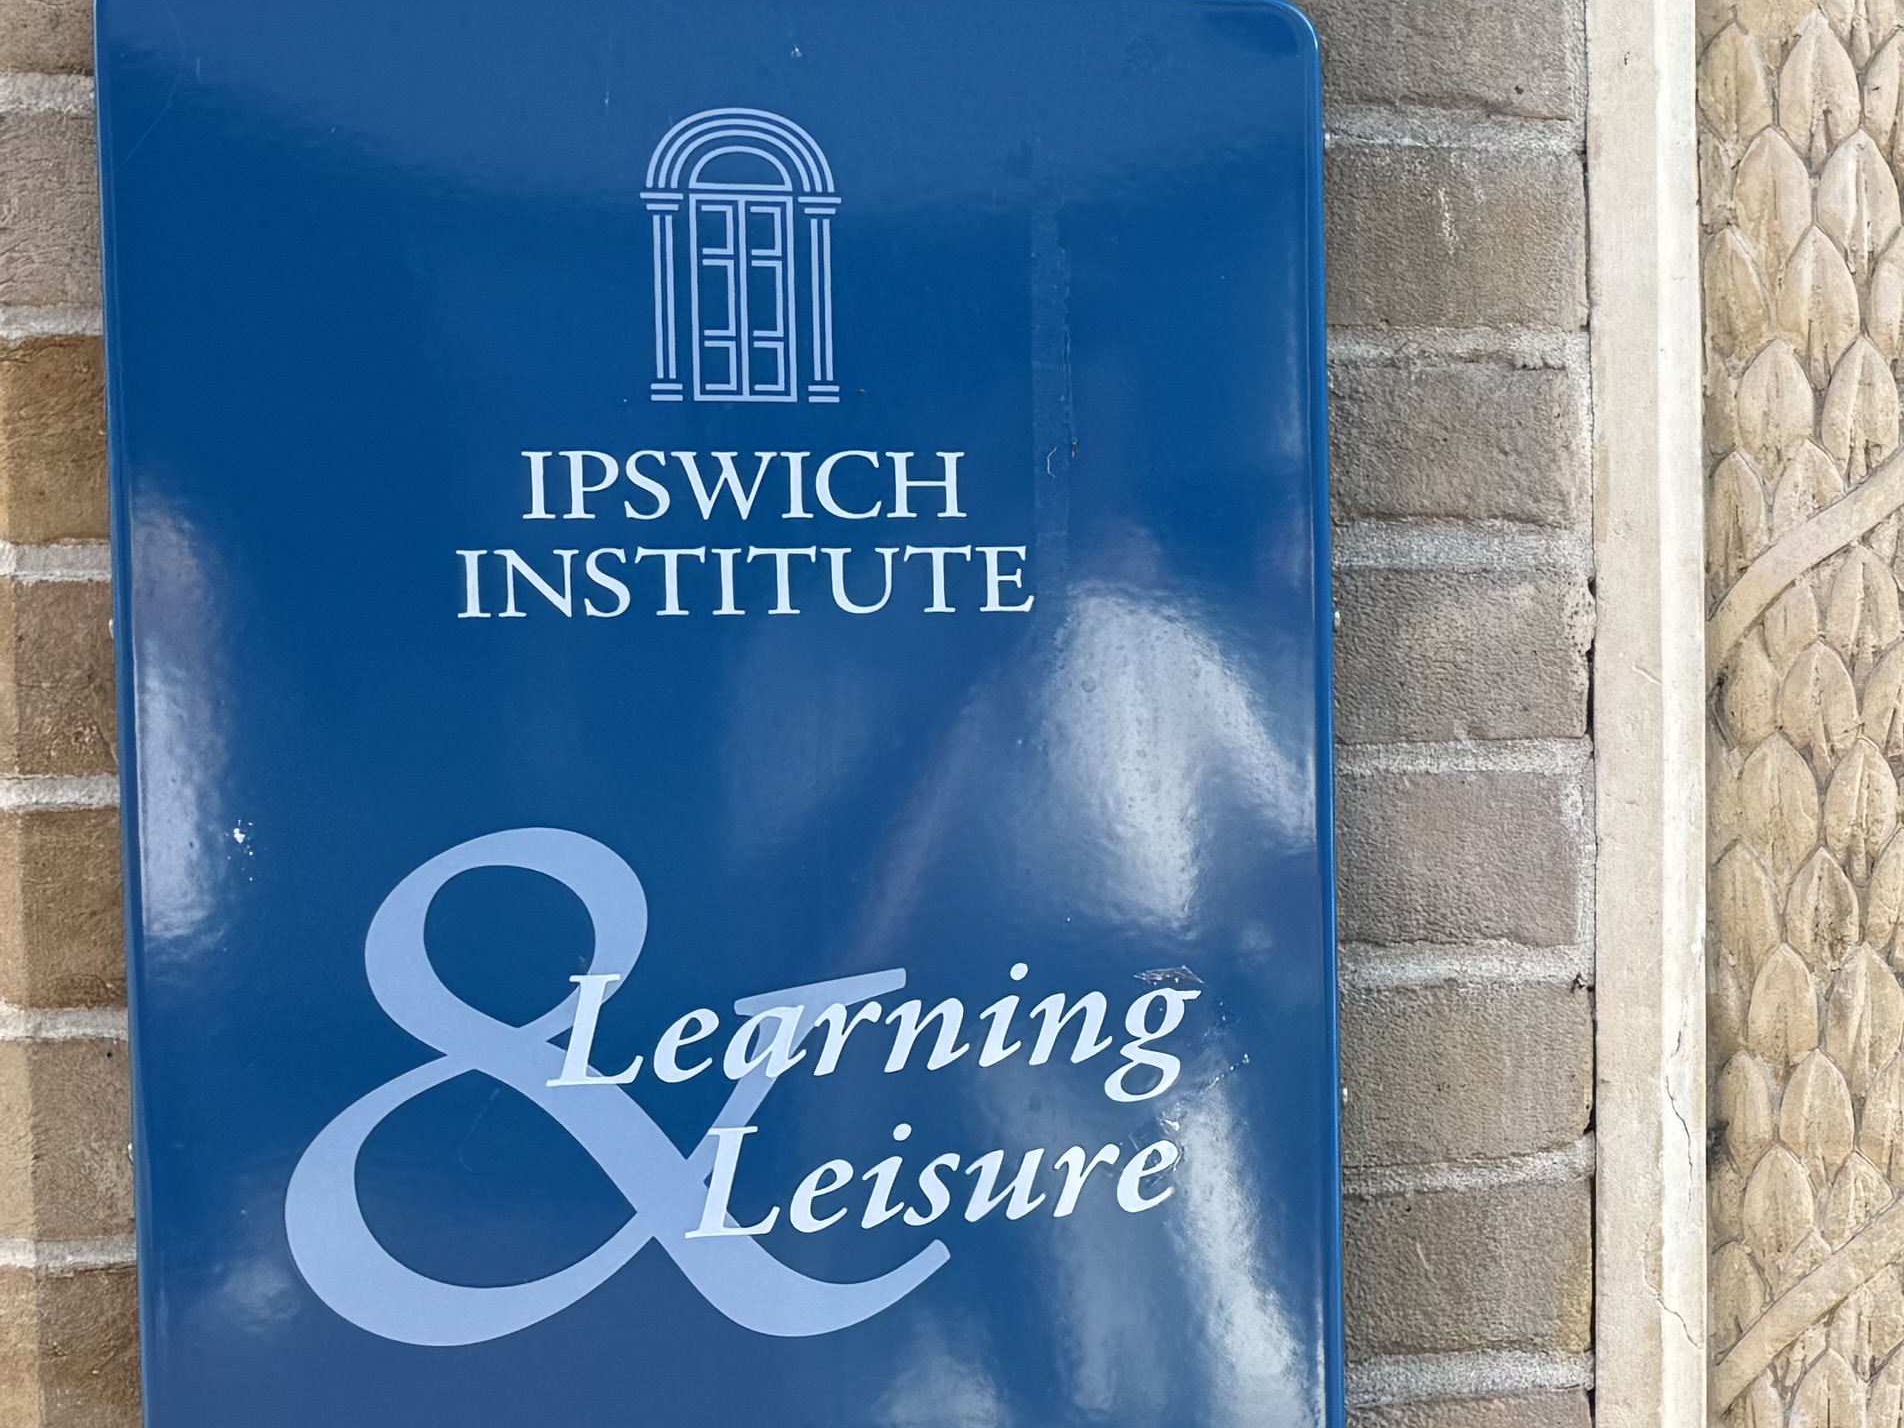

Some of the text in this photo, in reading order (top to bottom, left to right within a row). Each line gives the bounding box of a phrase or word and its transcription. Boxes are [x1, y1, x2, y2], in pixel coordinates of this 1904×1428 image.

[520, 448, 967, 520] IPSWICH
[455, 544, 1035, 619] INSTITUTE
[284, 826, 951, 1347] &
[545, 962, 1202, 1102] Learning
[684, 1124, 1181, 1239] Leisure
